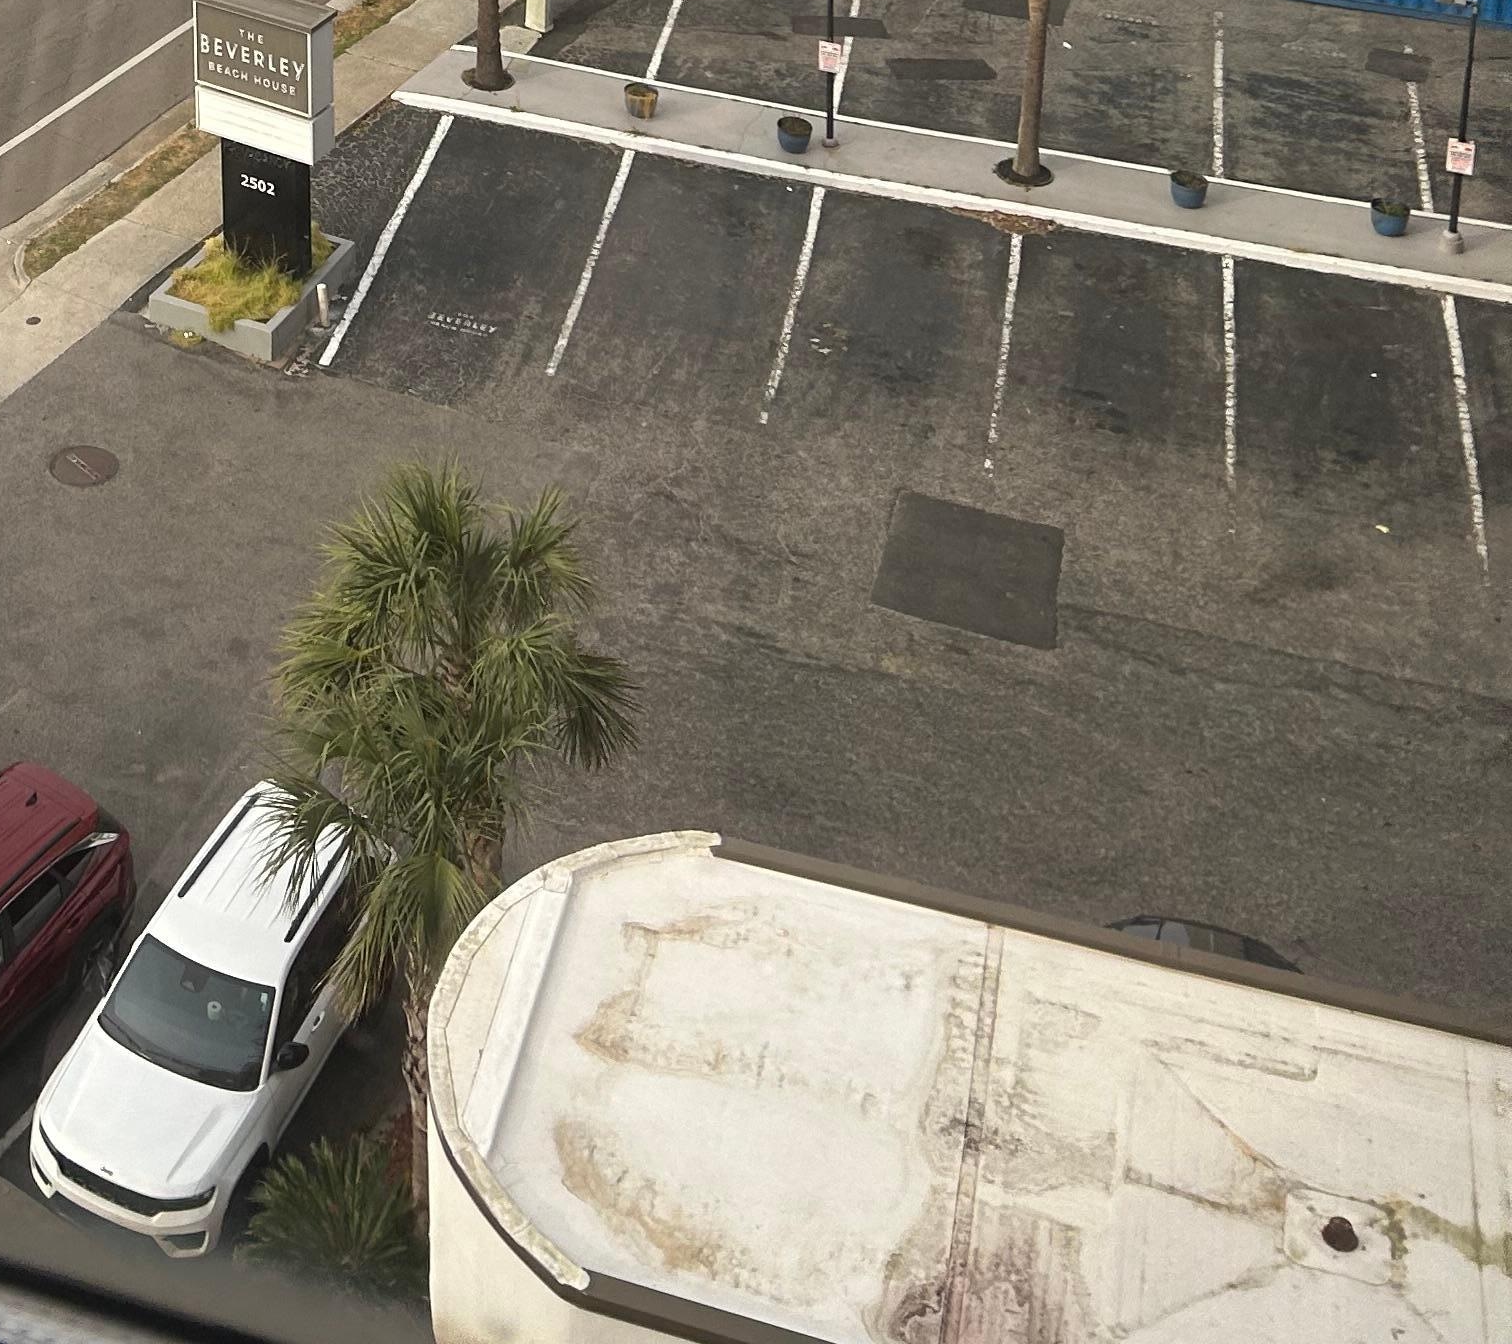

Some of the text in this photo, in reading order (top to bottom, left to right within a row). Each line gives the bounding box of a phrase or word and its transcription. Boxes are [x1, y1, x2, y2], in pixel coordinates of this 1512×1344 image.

[239, 28, 265, 44] THE
[200, 33, 305, 81] BEVERLEY
[208, 60, 296, 96] BEACH HOUSE
[240, 174, 275, 196] 2502
